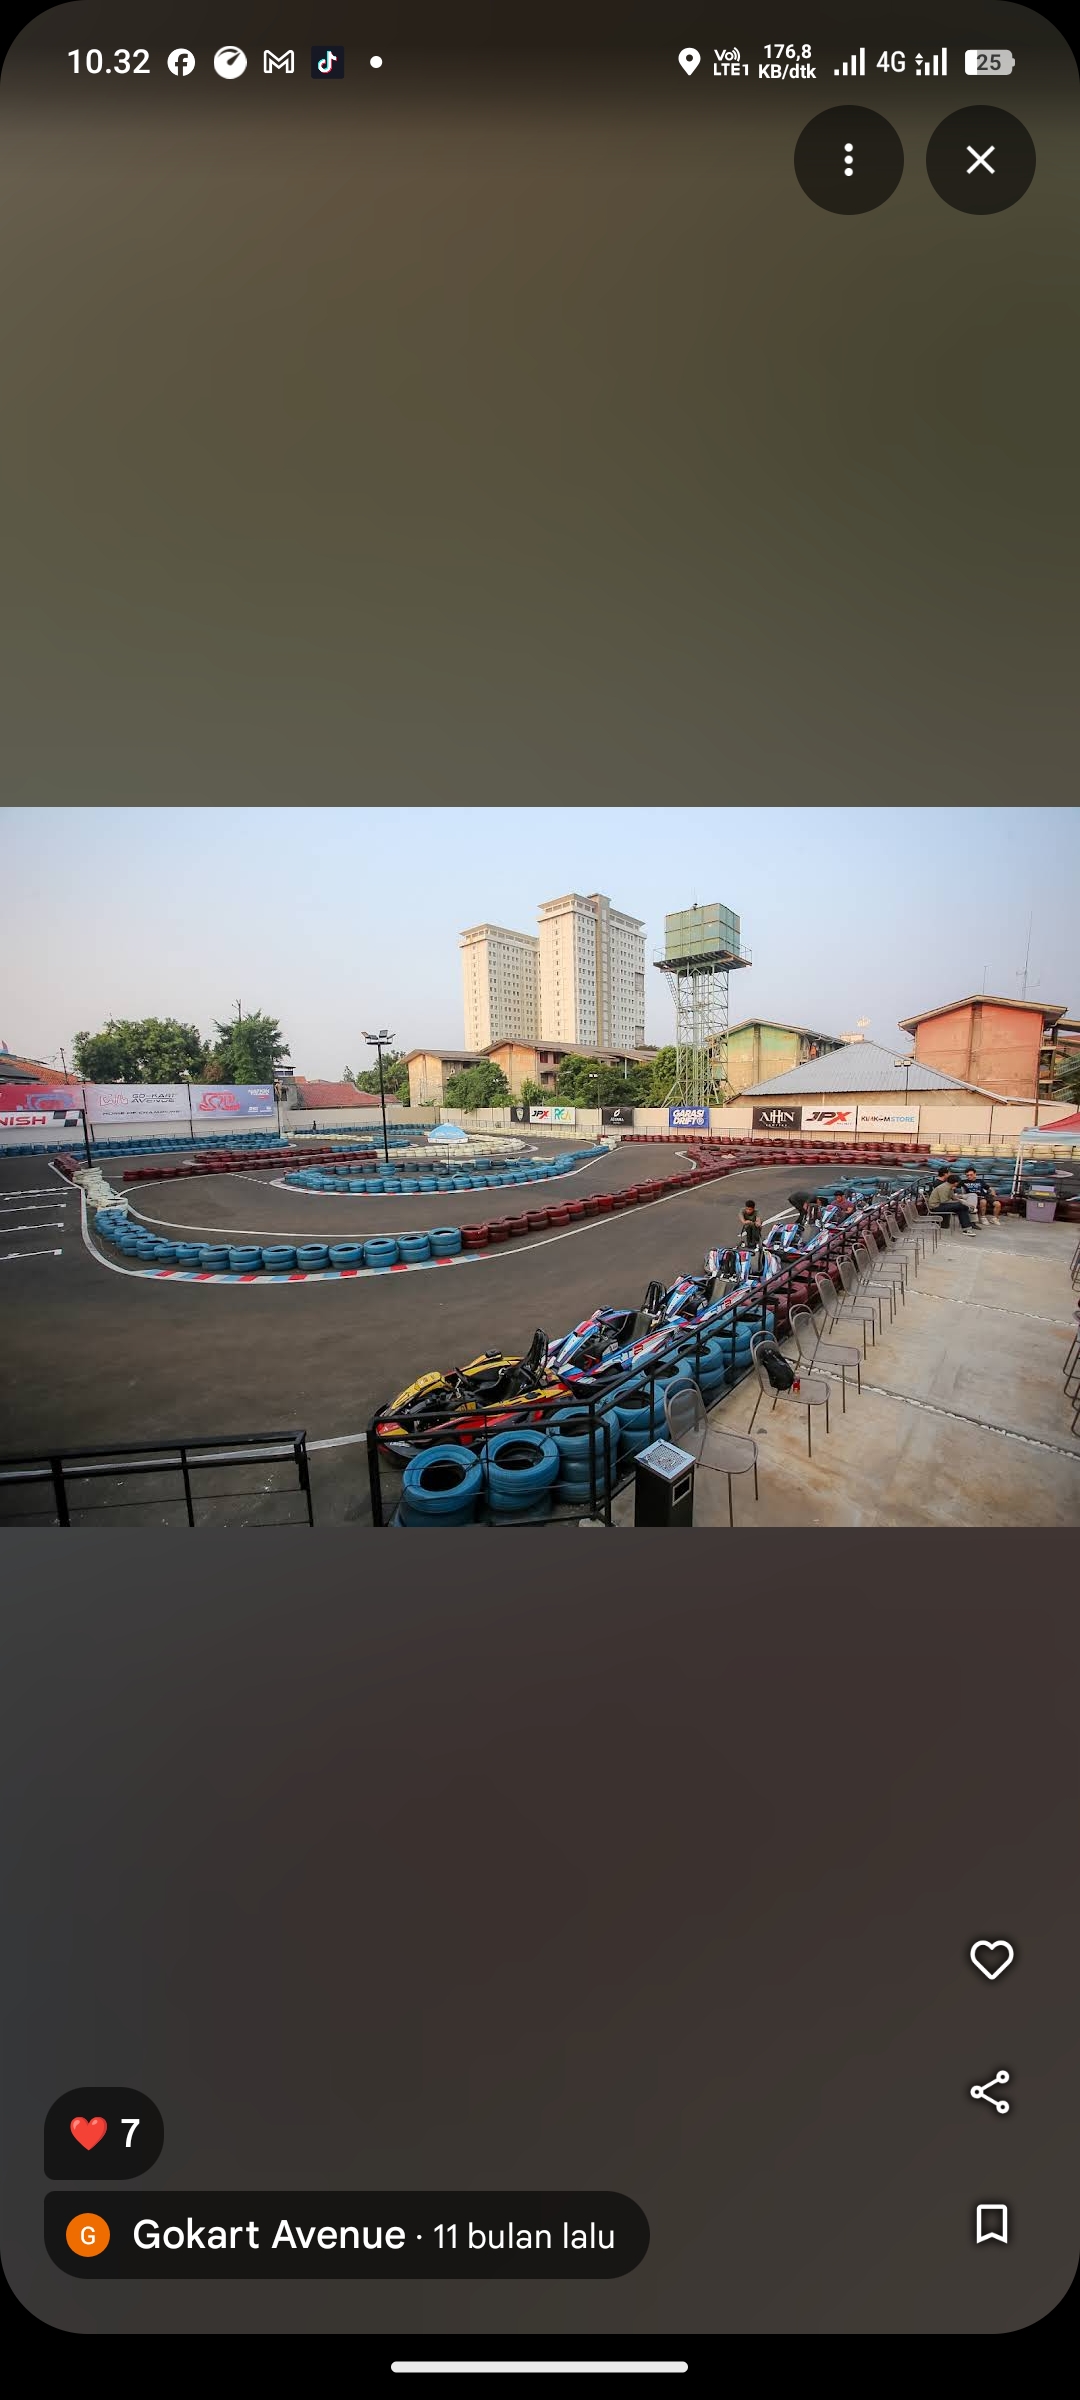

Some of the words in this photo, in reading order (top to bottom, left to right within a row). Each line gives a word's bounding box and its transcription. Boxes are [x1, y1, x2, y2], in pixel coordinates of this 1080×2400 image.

[531, 1110, 550, 1119] JPX
[672, 1109, 705, 1118] GARASI
[805, 1111, 853, 1125] JPX
[672, 1117, 698, 1125] DRIFT
